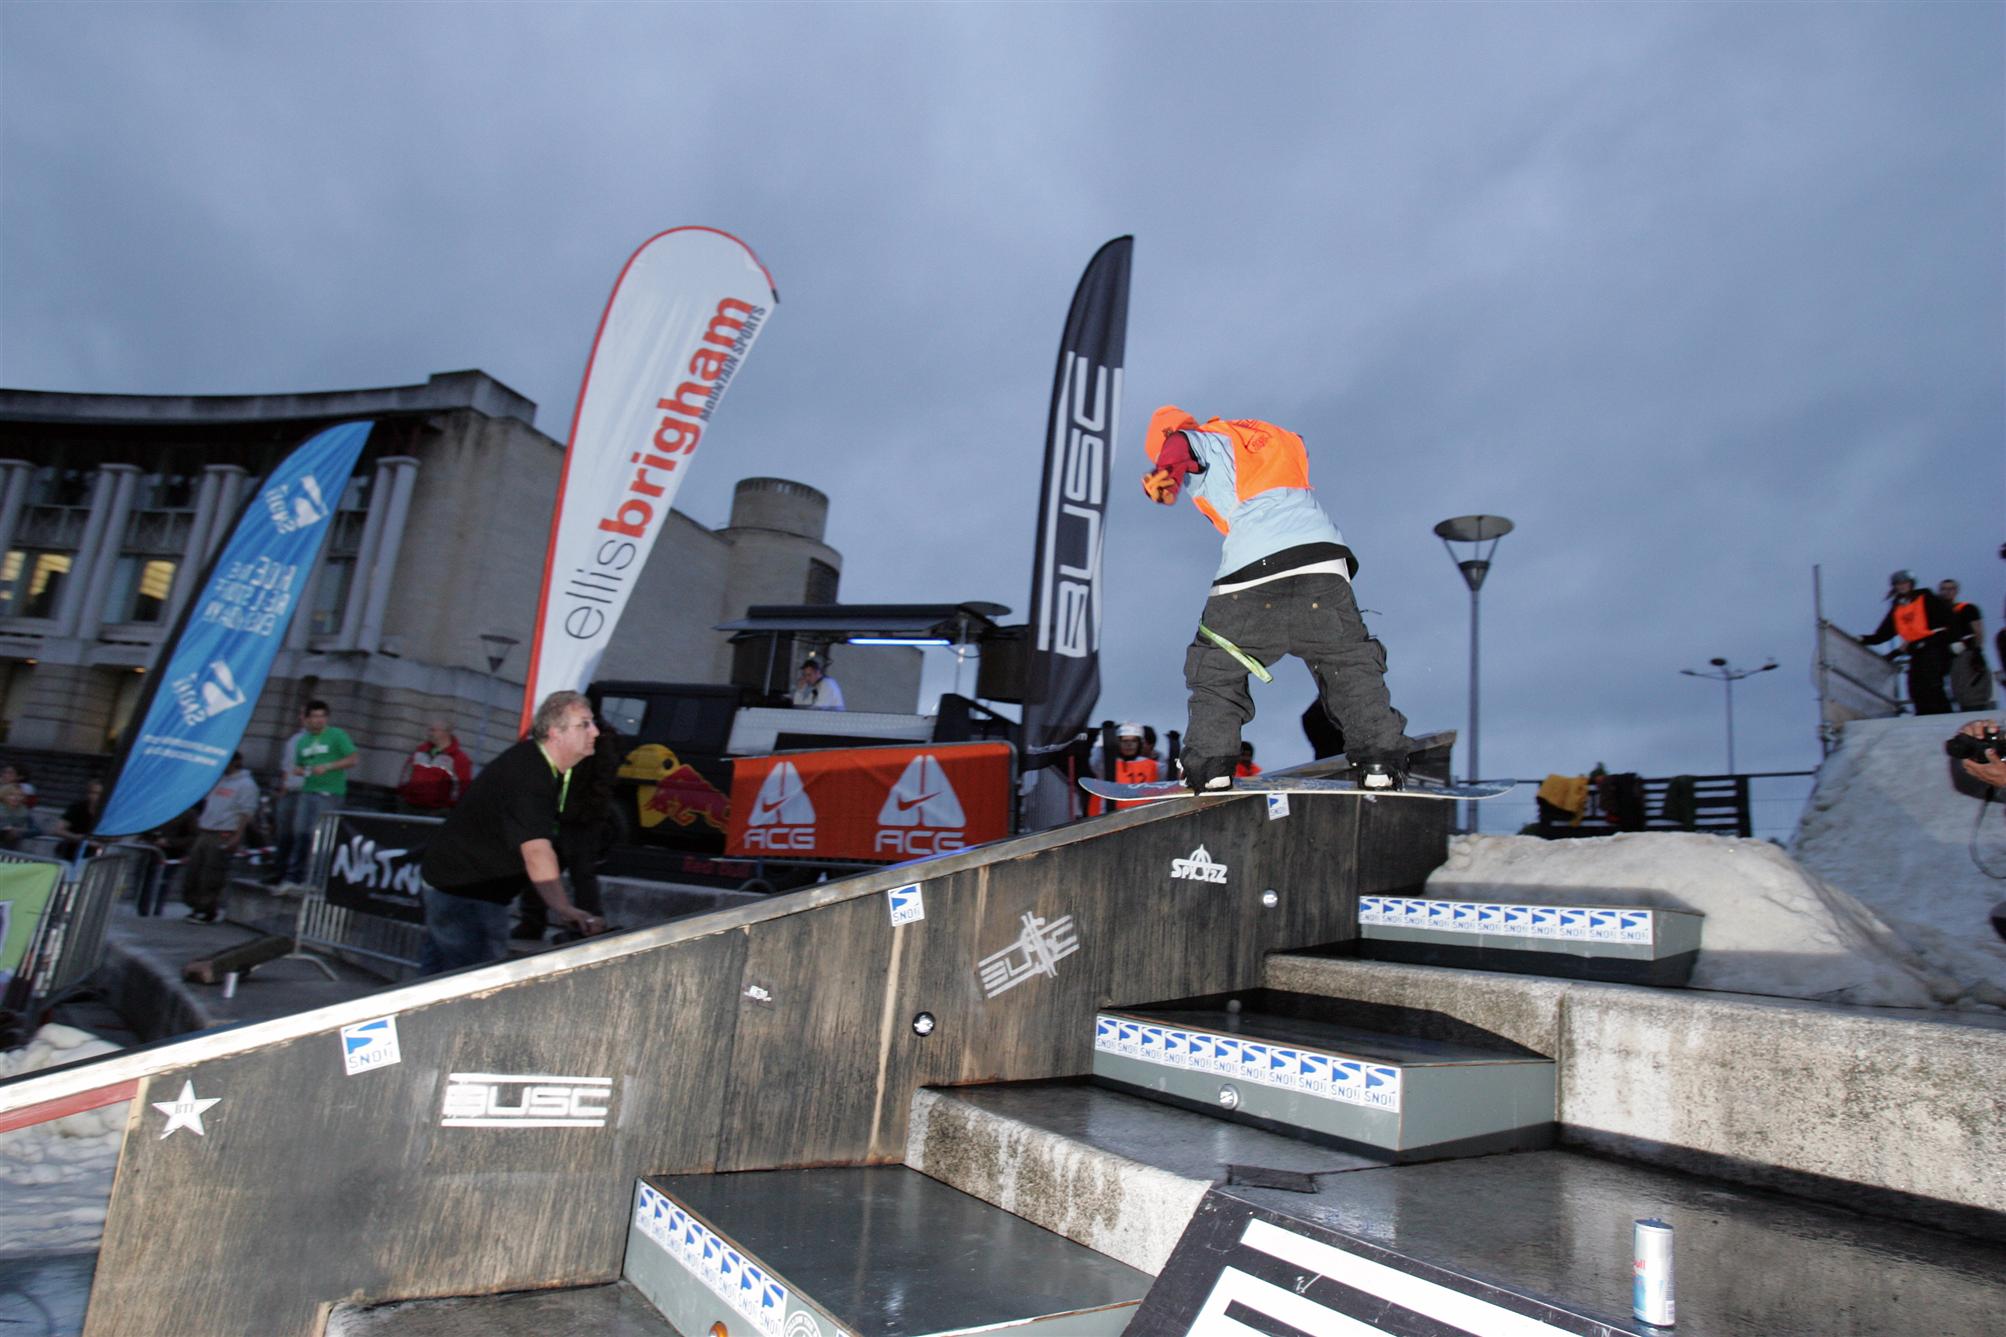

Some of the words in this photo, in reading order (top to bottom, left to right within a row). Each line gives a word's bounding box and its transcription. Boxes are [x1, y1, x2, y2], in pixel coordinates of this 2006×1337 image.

[699, 354, 739, 422] MOUNTAIN
[732, 305, 767, 356] SPORTS
[743, 828, 816, 850] ACG
[875, 830, 965, 855] ACG
